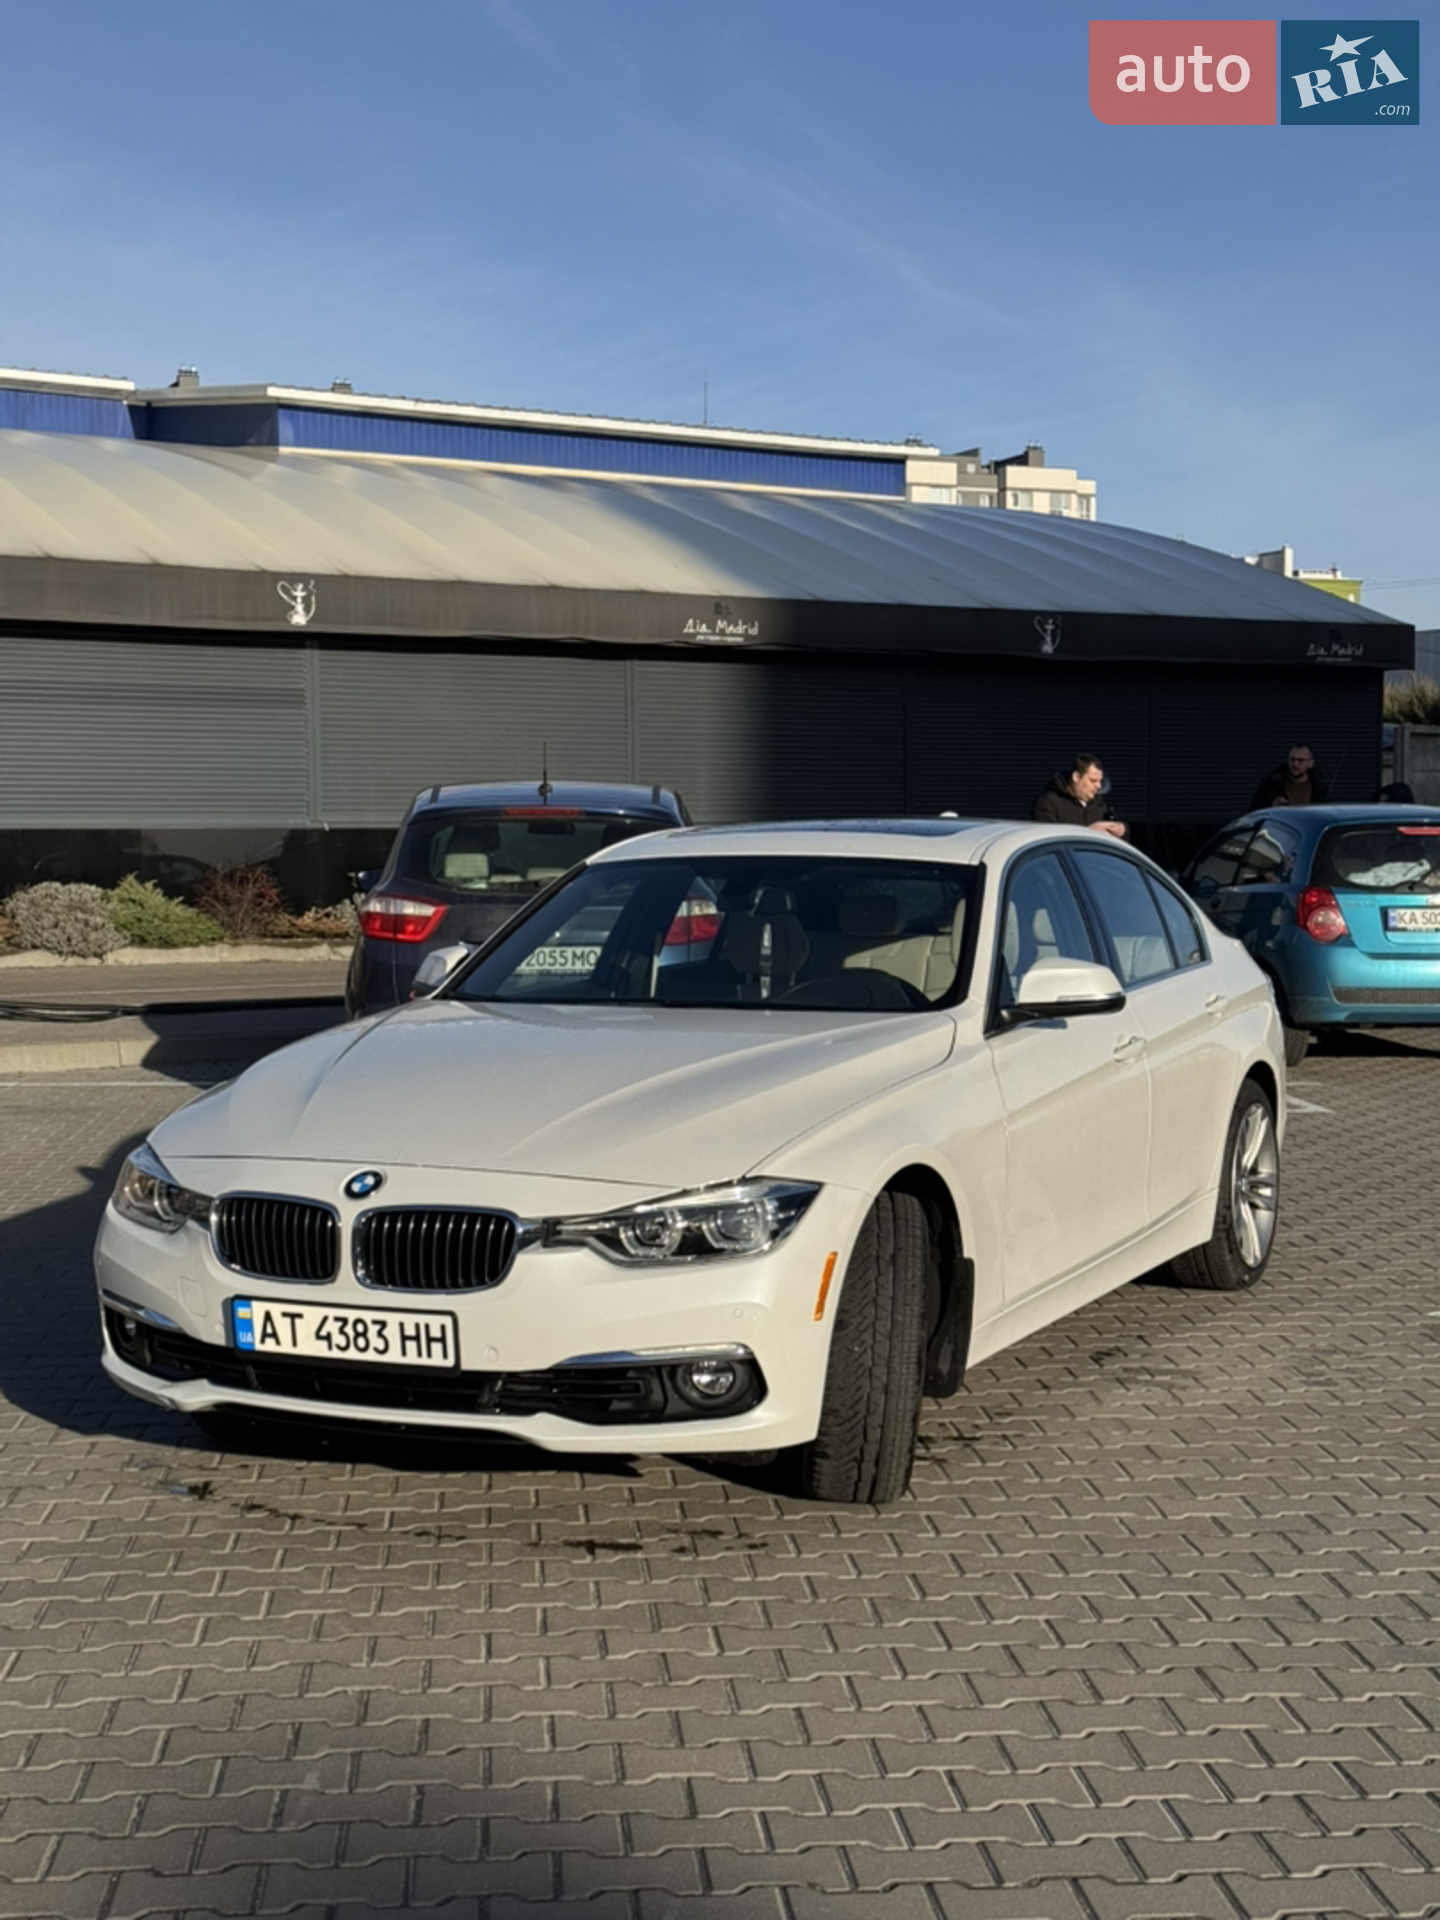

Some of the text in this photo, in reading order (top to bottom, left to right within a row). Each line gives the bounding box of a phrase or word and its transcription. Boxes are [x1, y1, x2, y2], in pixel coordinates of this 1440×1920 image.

[715, 618, 759, 636] Madrid
[1397, 911, 1418, 925] KA
[525, 949, 569, 967] 2055
[239, 1331, 253, 1344] UA
[259, 1309, 449, 1360] AT 4383 HH
